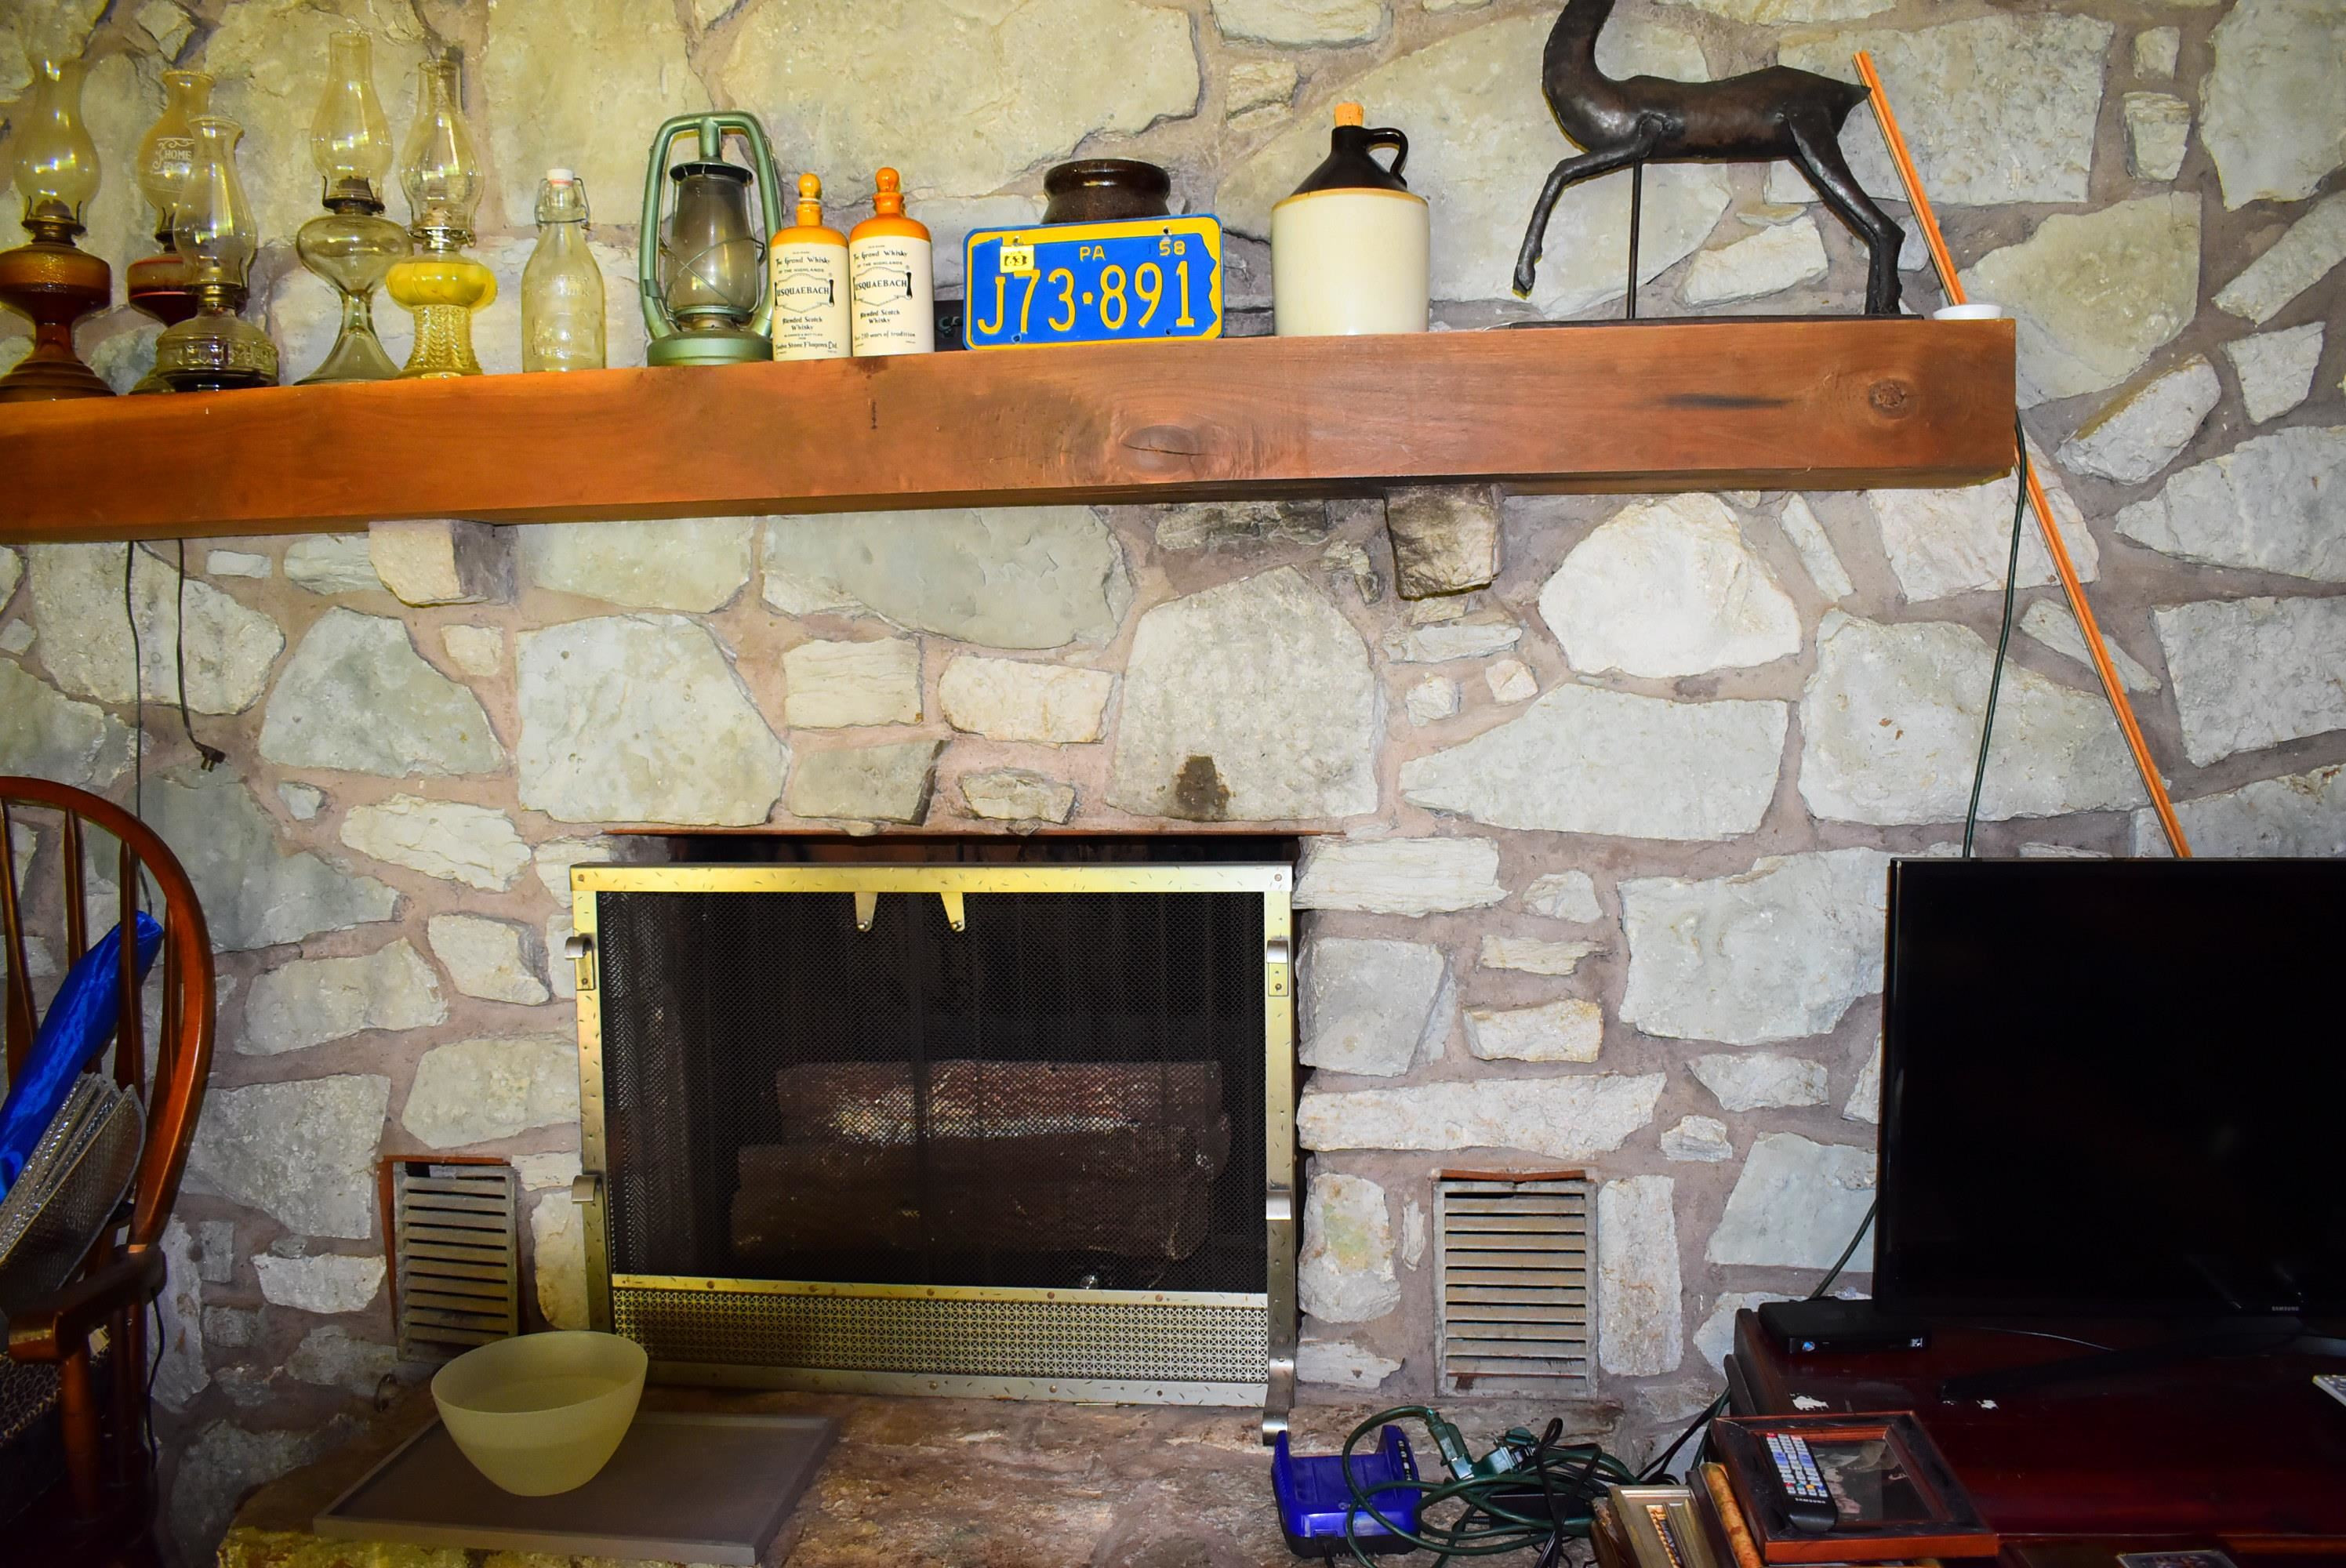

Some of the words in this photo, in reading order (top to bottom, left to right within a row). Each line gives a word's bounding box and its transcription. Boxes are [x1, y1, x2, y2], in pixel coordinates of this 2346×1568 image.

[164, 150, 192, 161] HOME
[1079, 245, 1106, 261] PA
[1158, 240, 1186, 257] 58
[861, 251, 880, 260] Grand
[883, 249, 907, 258] Whisky
[784, 256, 804, 267] Grand
[807, 256, 830, 264] Whisky
[776, 286, 829, 297] USQUAEBACH
